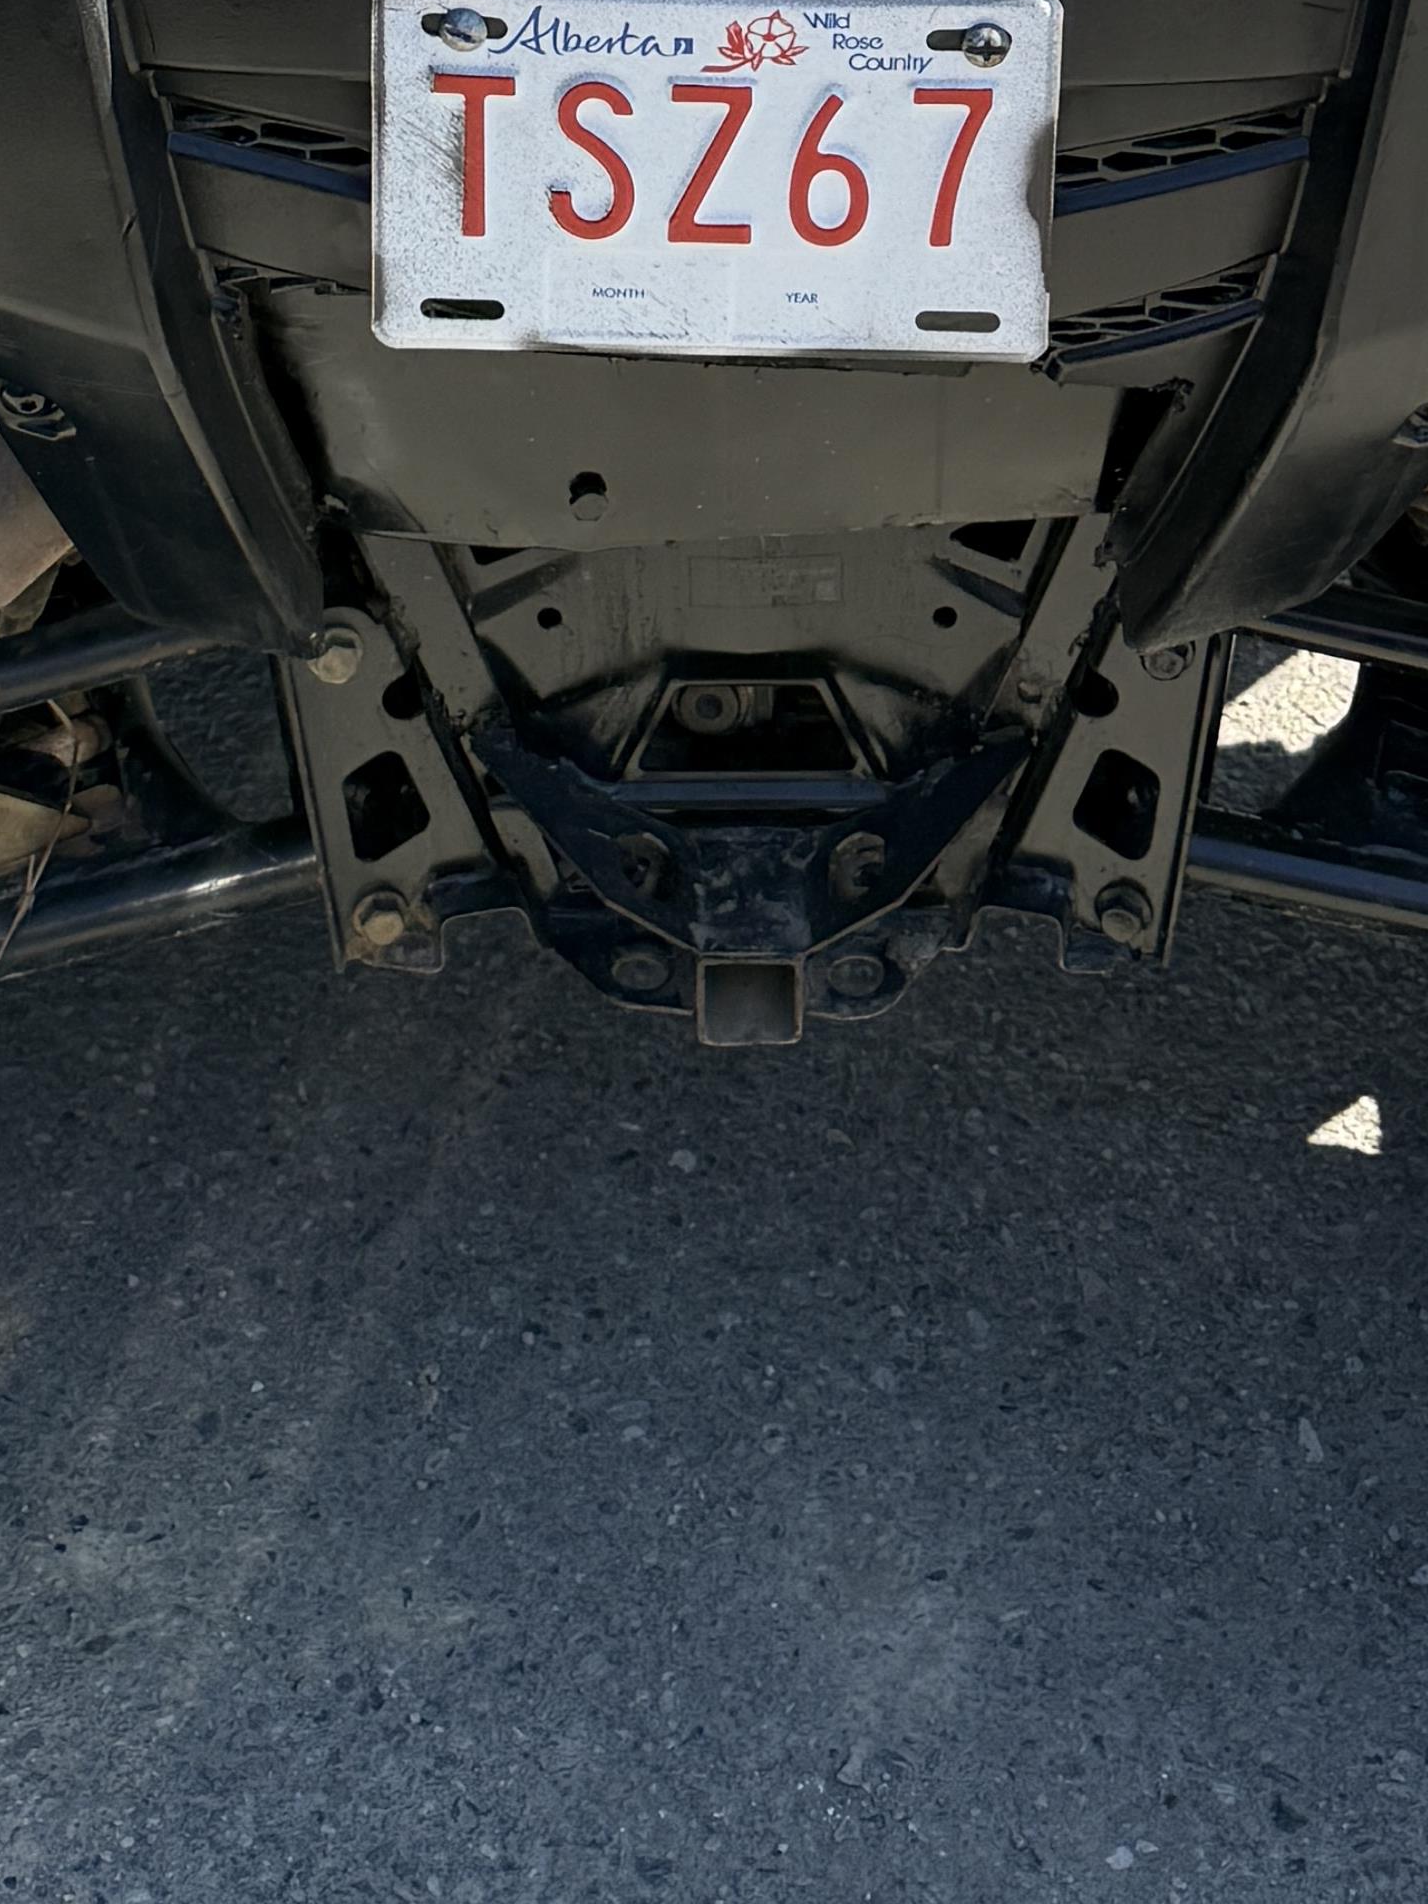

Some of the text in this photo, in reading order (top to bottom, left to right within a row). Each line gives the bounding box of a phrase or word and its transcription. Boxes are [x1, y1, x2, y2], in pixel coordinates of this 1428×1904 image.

[803, 12, 851, 30] Wild
[488, 5, 673, 56] Alberta
[832, 33, 884, 50] Rose
[849, 53, 934, 73] Country
[431, 73, 993, 247] TSZ67
[592, 287, 645, 299] MONTH
[785, 292, 819, 304] YEAR
